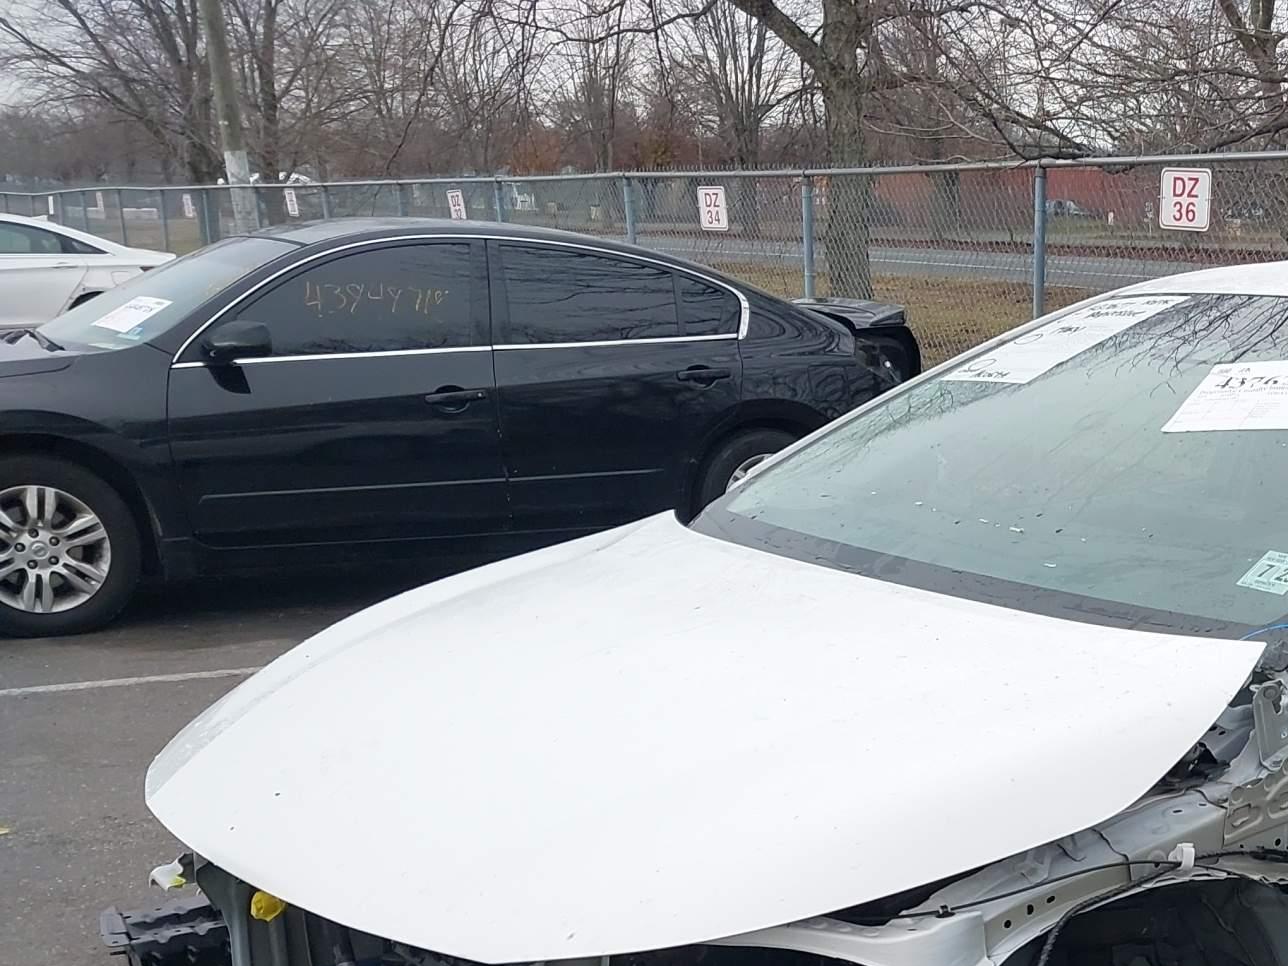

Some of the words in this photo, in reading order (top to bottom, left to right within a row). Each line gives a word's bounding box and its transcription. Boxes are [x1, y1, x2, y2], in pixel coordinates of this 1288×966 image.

[1172, 176, 1200, 198] DZ
[704, 192, 720, 208] DZ
[706, 210, 721, 225] 34
[1172, 201, 1196, 223] 36
[1257, 563, 1276, 578] 7
